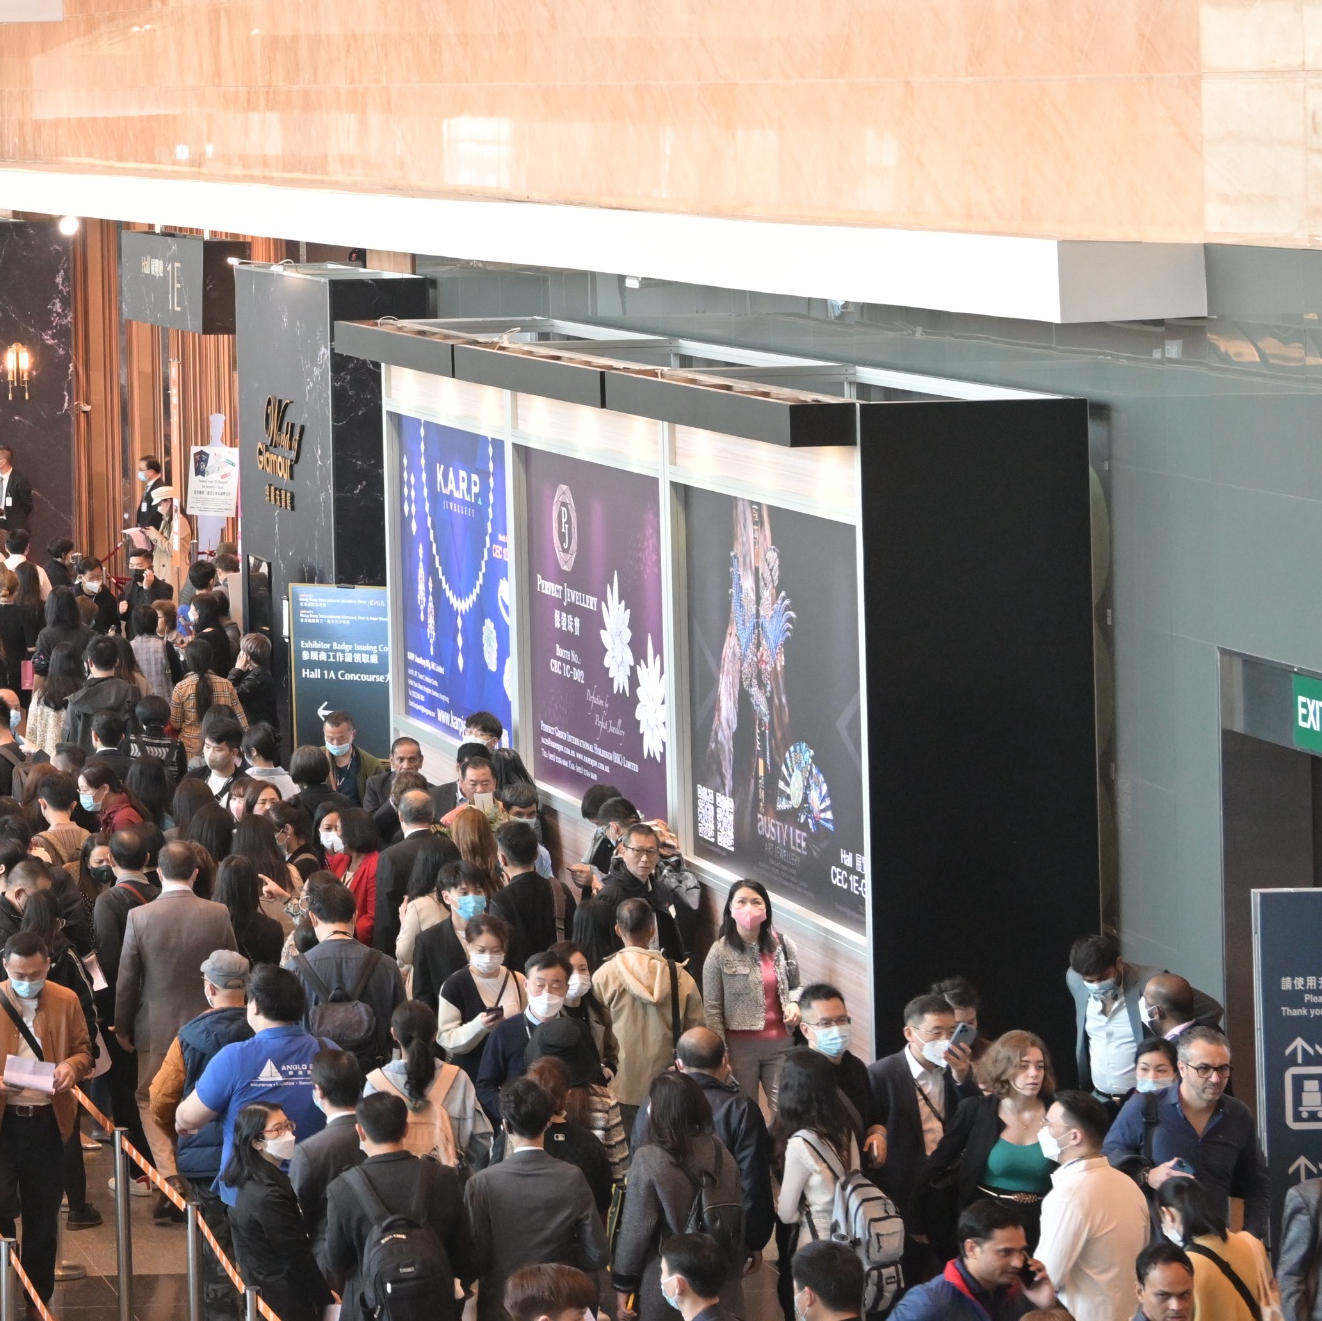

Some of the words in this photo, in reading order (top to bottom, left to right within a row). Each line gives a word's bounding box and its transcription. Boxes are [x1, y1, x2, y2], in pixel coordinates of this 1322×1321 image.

[141, 255, 151, 274] Hall
[165, 262, 182, 312] 1E
[256, 441, 294, 481] Glamour
[442, 499, 475, 518] JEWELLERY
[537, 574, 562, 604] PERFECT
[563, 583, 598, 612] JEWELLERY
[554, 609, 581, 637] 保發珠寶
[300, 640, 331, 649] Exhibitor
[333, 642, 353, 652] Badge
[355, 643, 378, 653] Issuing
[302, 668, 321, 679] Hall
[324, 670, 336, 679] 1A
[790, 826, 808, 856] LEE
[840, 848, 853, 868] Hall
[831, 865, 847, 889] CEC
[1281, 1007, 1307, 1016] Thank
